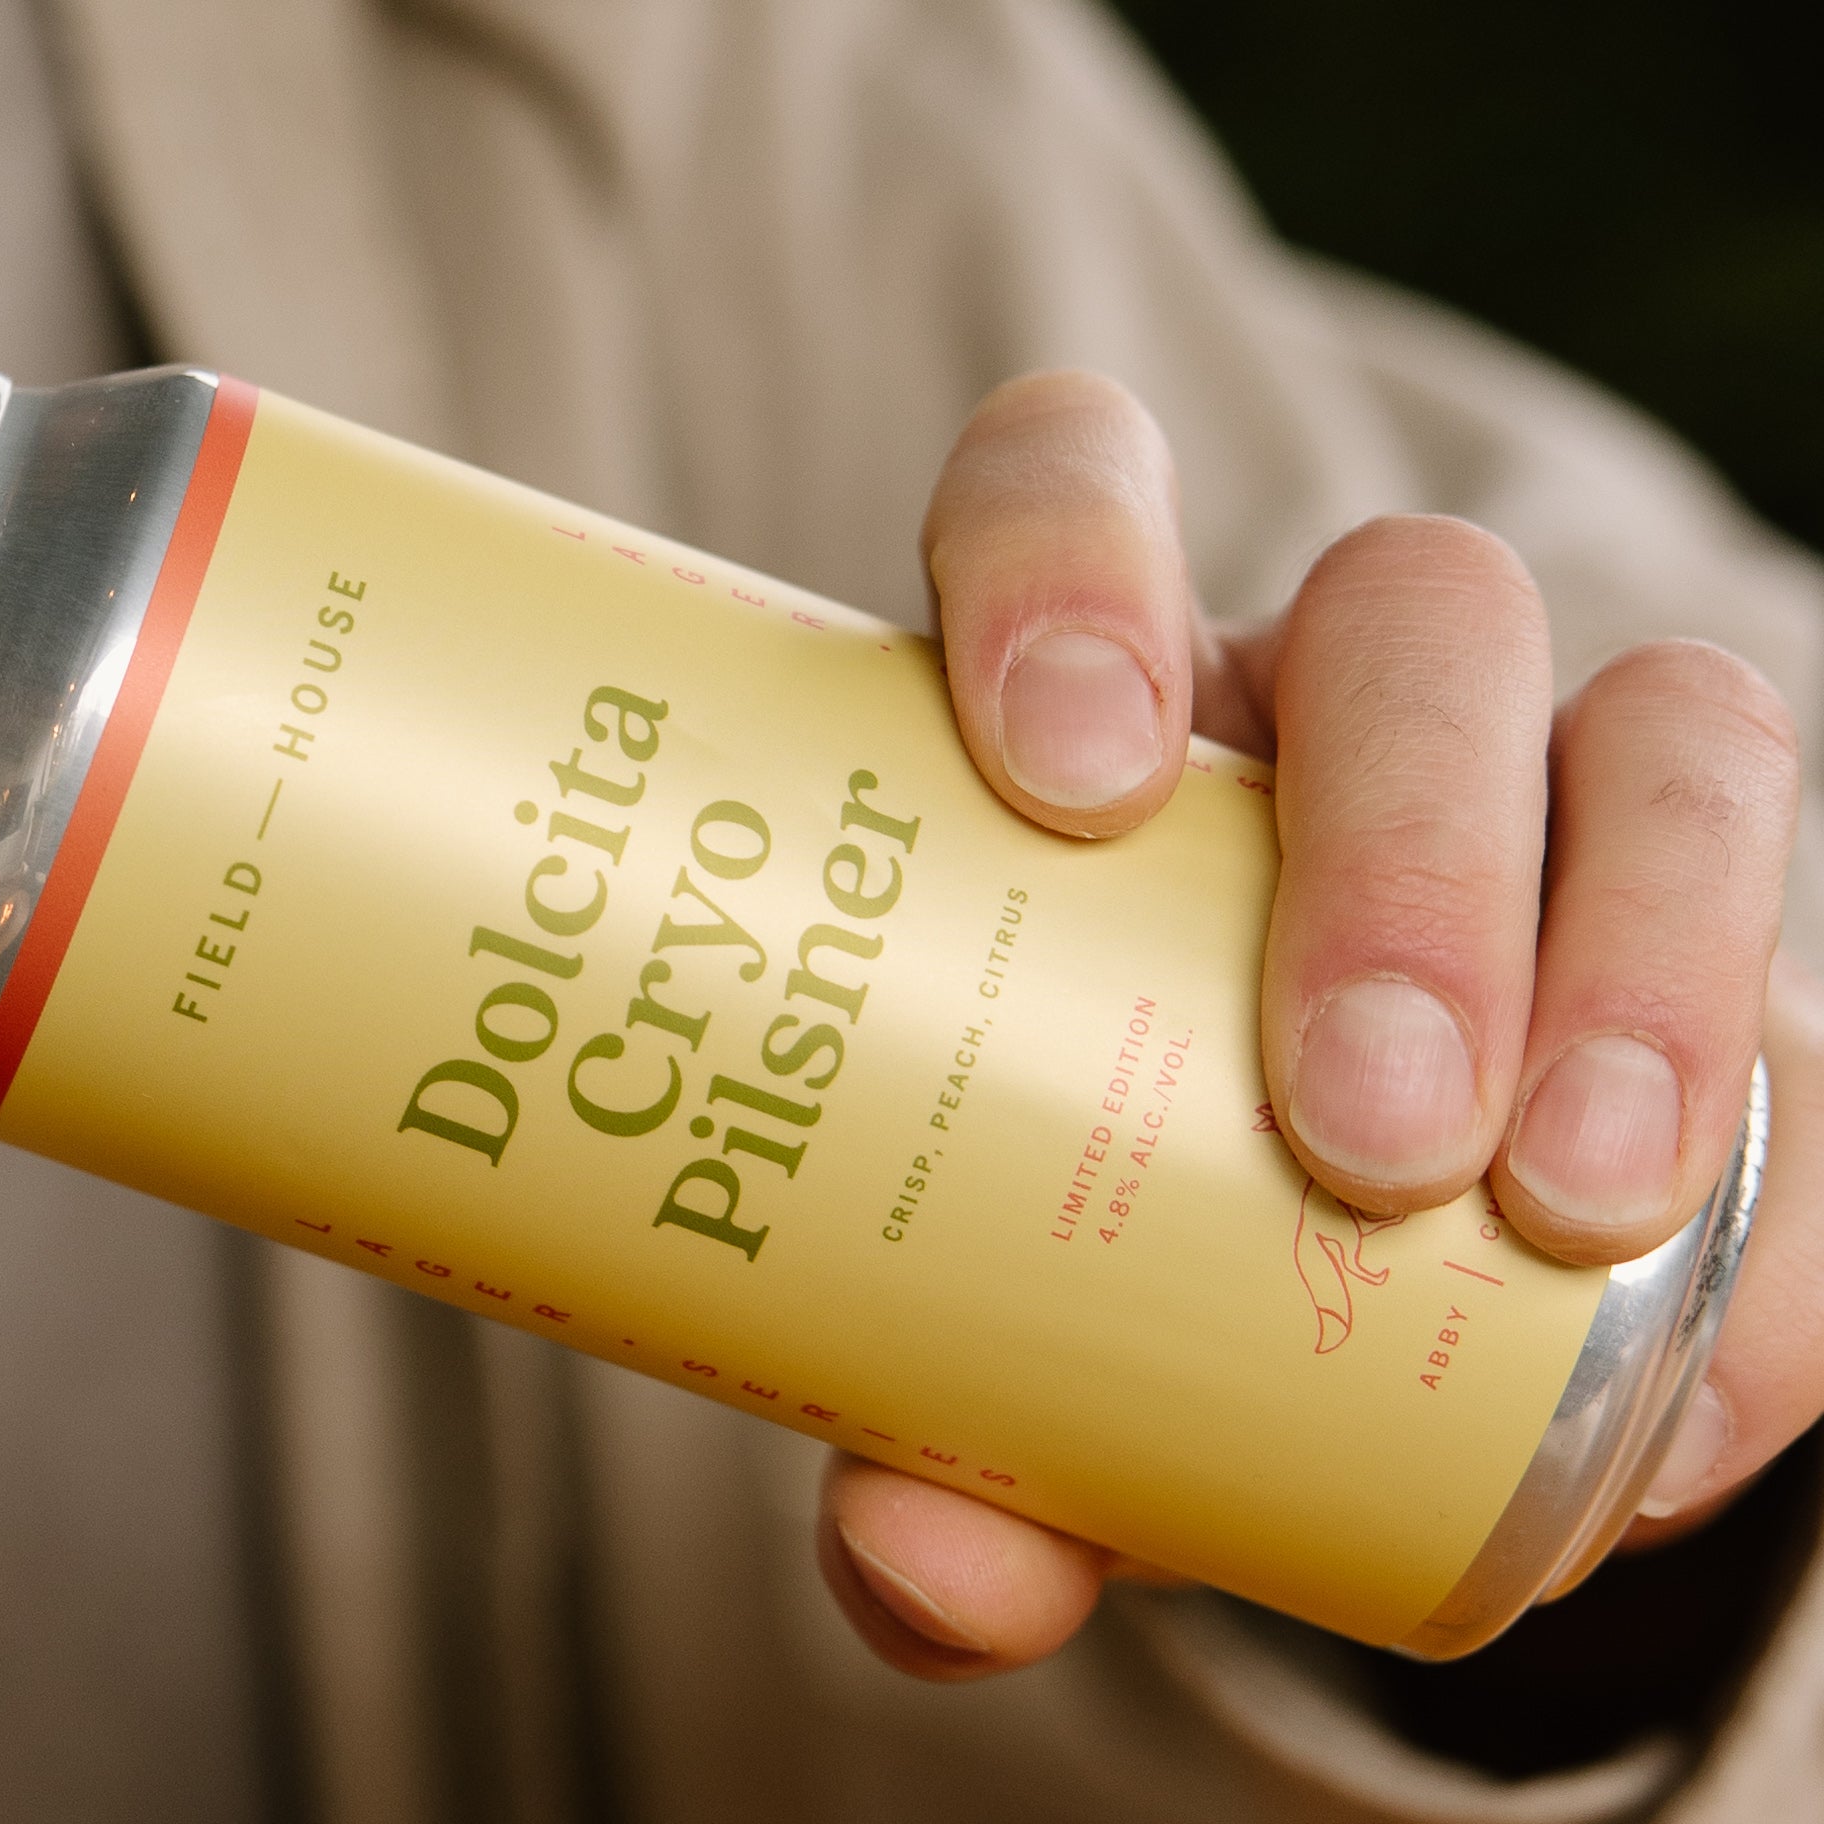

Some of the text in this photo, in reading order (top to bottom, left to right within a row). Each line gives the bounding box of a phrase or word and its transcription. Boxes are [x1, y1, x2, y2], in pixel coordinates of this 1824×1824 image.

[172, 571, 367, 1023] FIELD HOUSE
[397, 684, 669, 1168] Dolcita
[567, 799, 772, 1138] Cryo
[651, 768, 923, 1264] Pilsner
[882, 887, 1029, 1243] CRISP, PEACH, CITRUS
[1050, 996, 1157, 1242] LIMITED EDITION
[294, 1217, 1018, 1488] LAGER SERIES
[1098, 1178, 1140, 1245] 4.8%
[1420, 1305, 1469, 1391] ABBY
